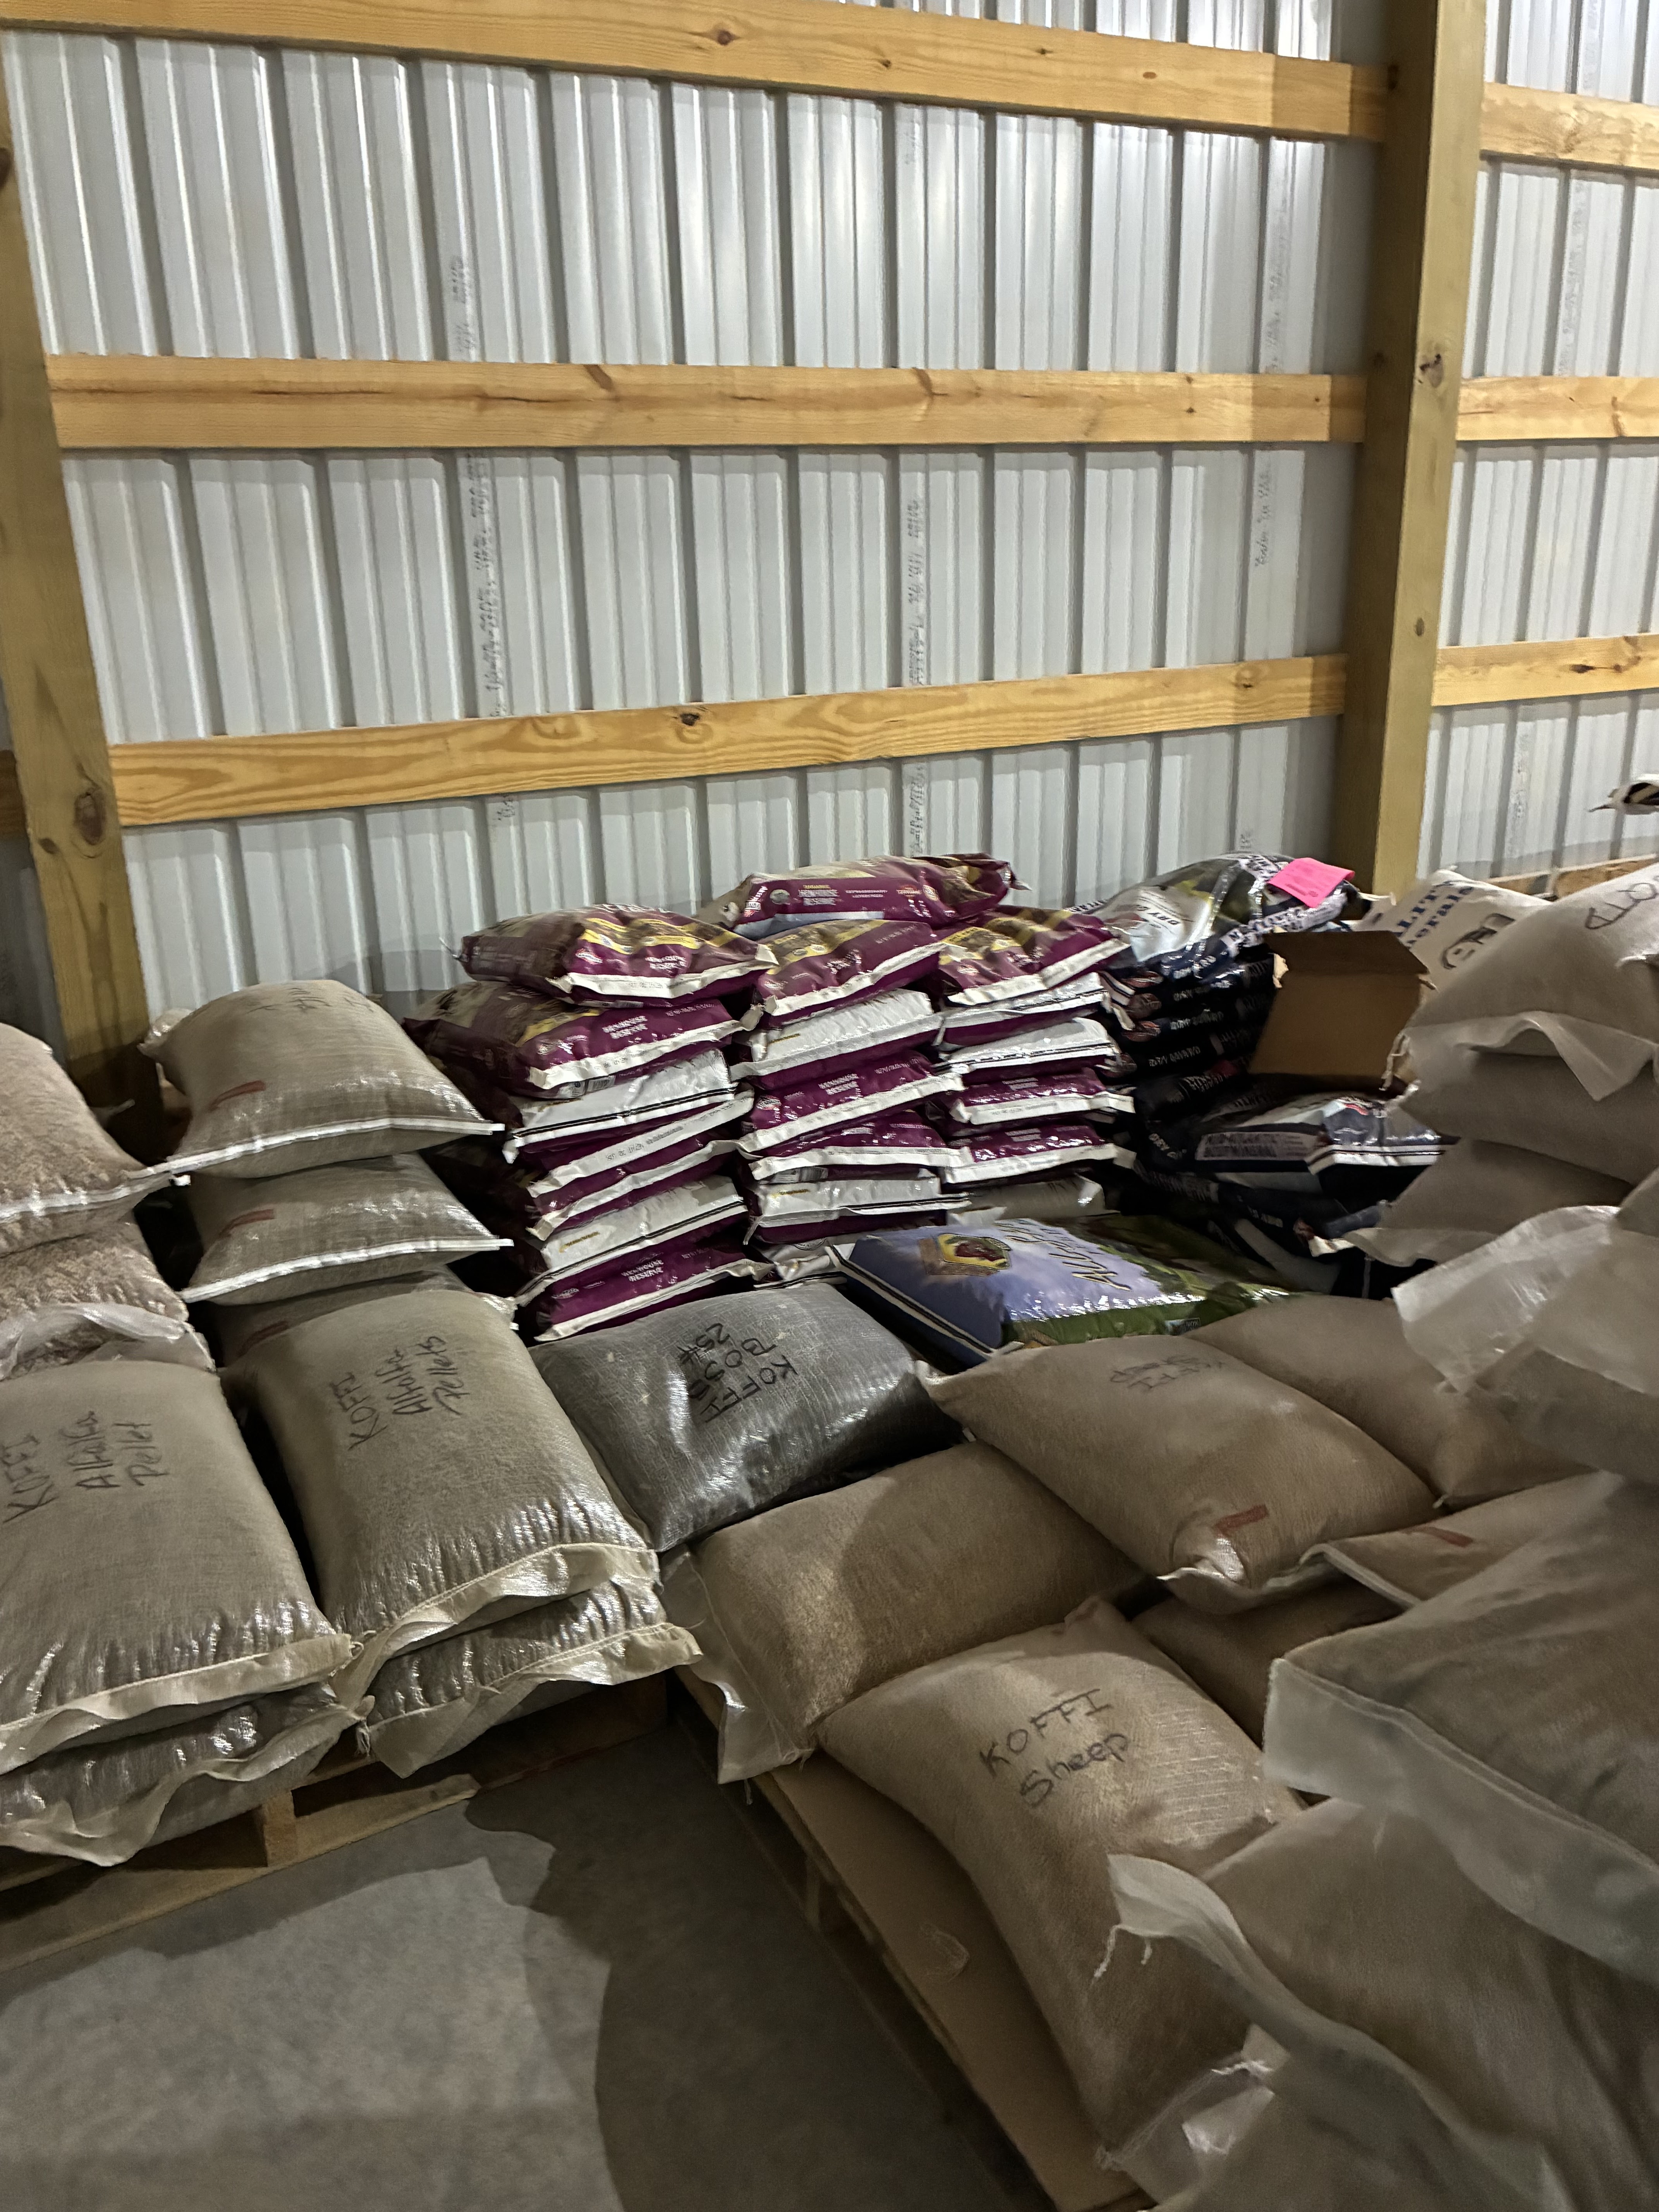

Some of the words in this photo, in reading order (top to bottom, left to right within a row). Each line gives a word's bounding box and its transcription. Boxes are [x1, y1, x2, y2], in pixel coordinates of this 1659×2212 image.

[629, 1266, 664, 1282] RESERVE
[677, 1322, 730, 1365] 25#
[329, 1372, 388, 1451] KOFFI
[700, 1355, 799, 1423] KOFFI
[979, 1689, 1112, 1777] KOFFI
[1020, 1733, 1129, 1807] Sheep
